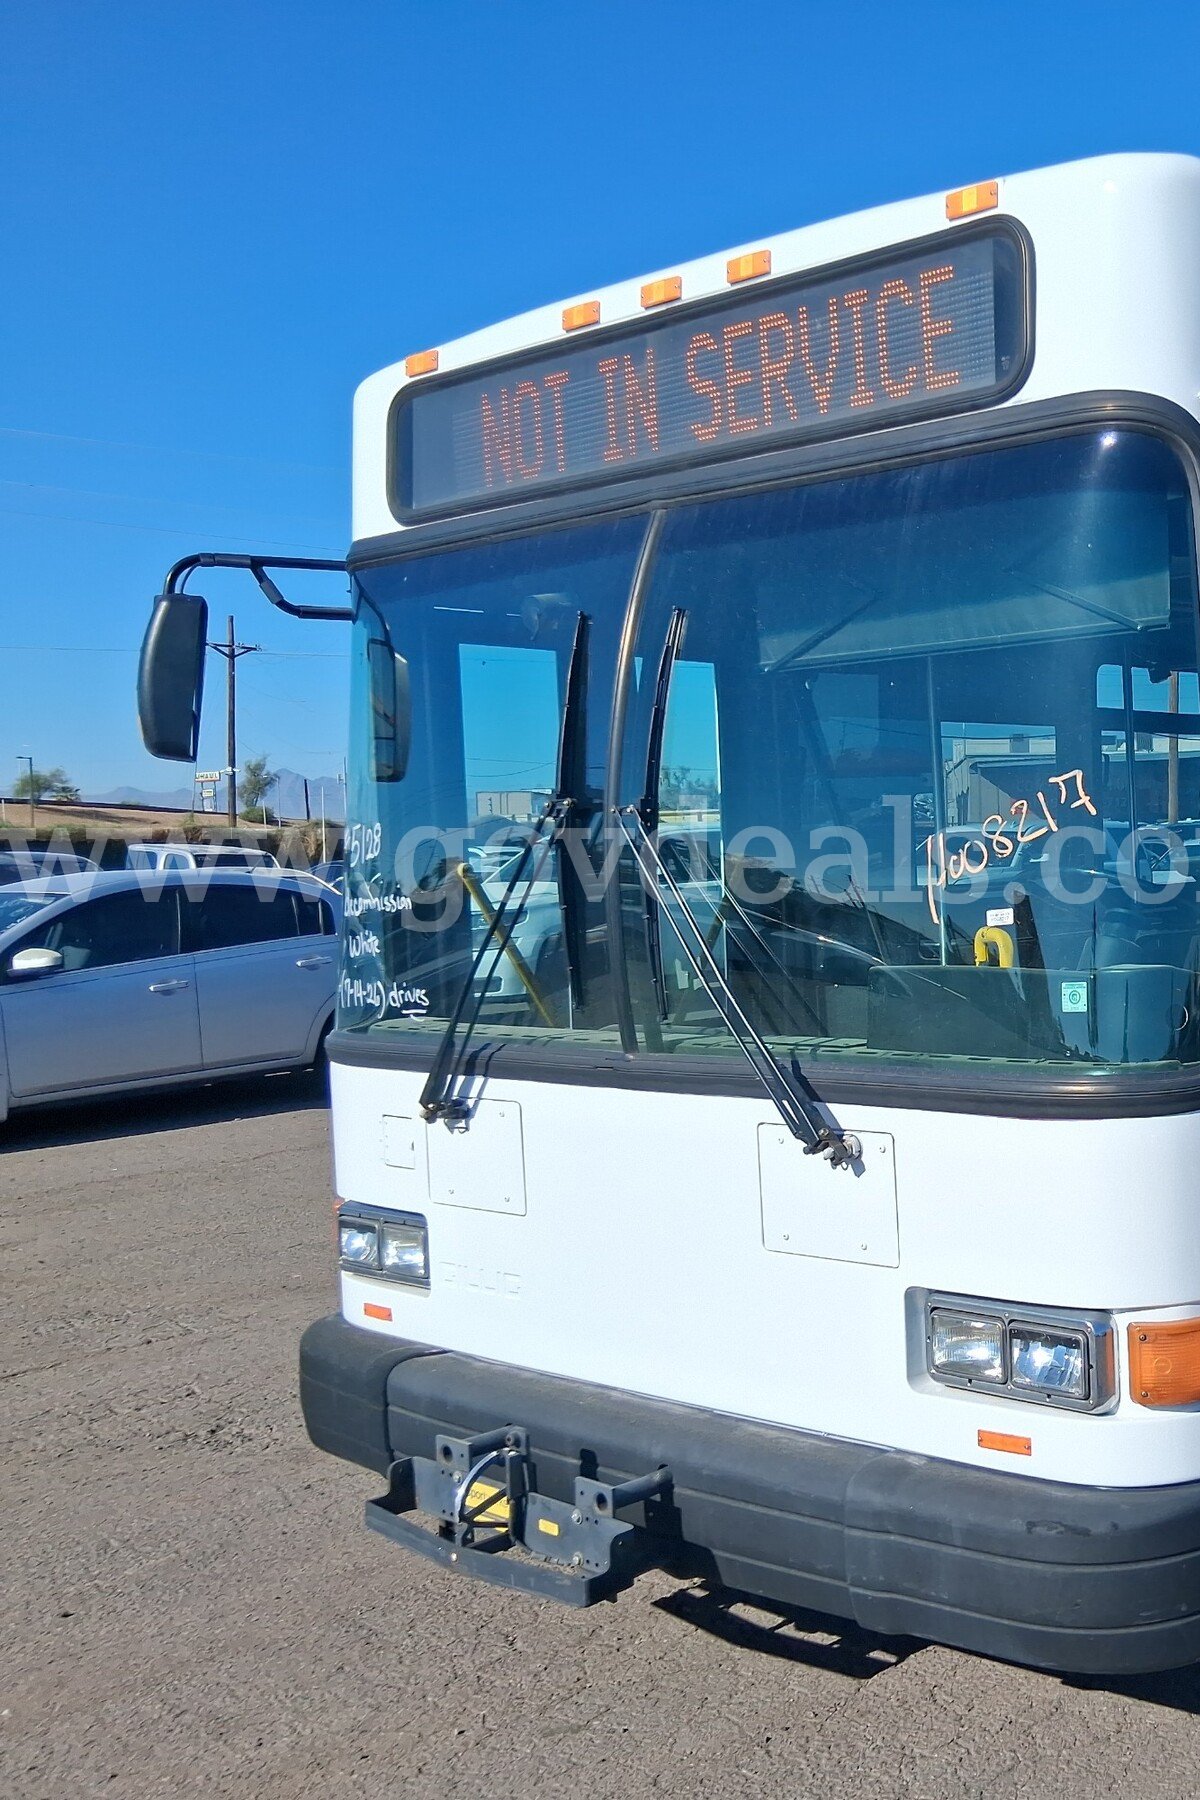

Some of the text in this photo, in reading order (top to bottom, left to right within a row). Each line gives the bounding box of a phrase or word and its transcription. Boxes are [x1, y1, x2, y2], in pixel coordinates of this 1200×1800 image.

[481, 265, 960, 487] NOT IN SERVICE
[389, 981, 430, 1007] drives
